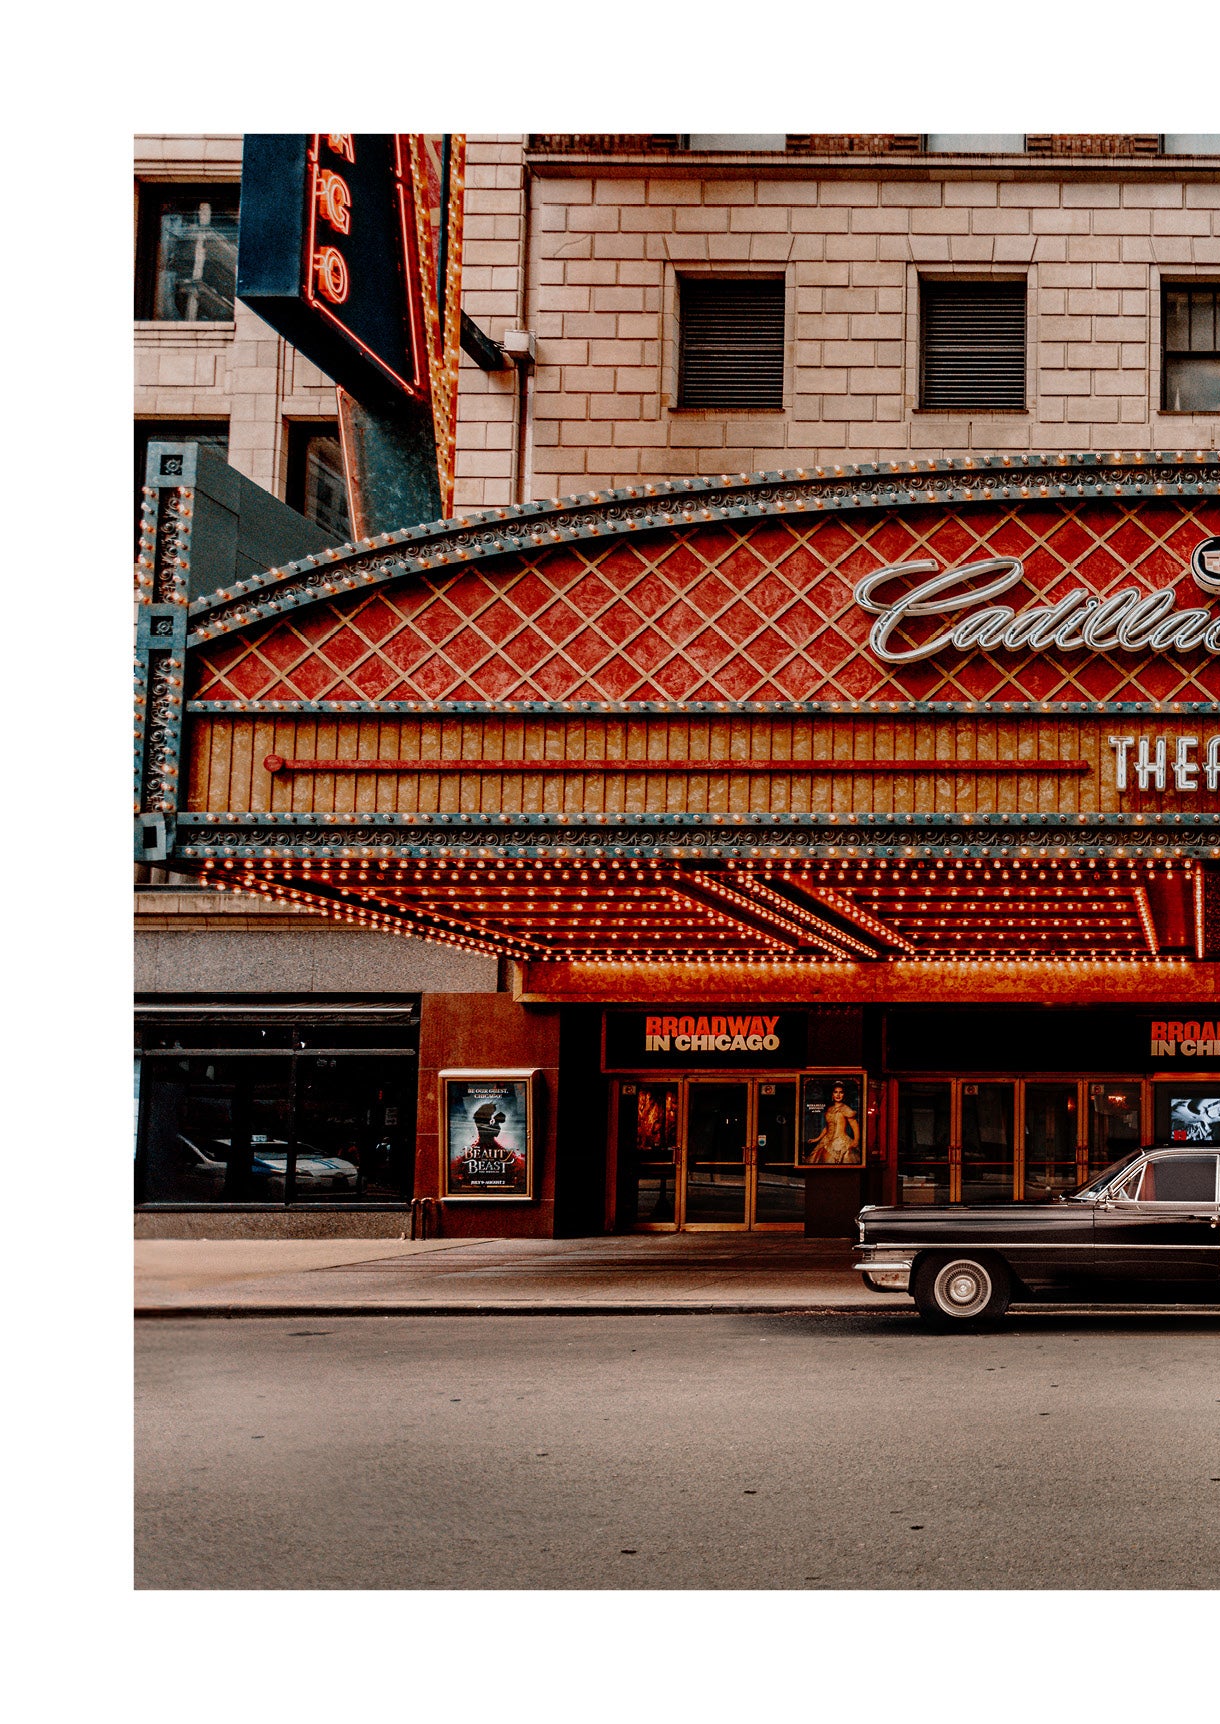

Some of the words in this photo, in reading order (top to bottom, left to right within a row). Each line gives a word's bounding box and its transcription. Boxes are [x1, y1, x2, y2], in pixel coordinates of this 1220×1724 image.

[645, 1015, 780, 1037] BROADWAY
[645, 1034, 671, 1051] IN
[674, 1034, 780, 1051] CHICAGO
[1151, 1039, 1176, 1056] IN
